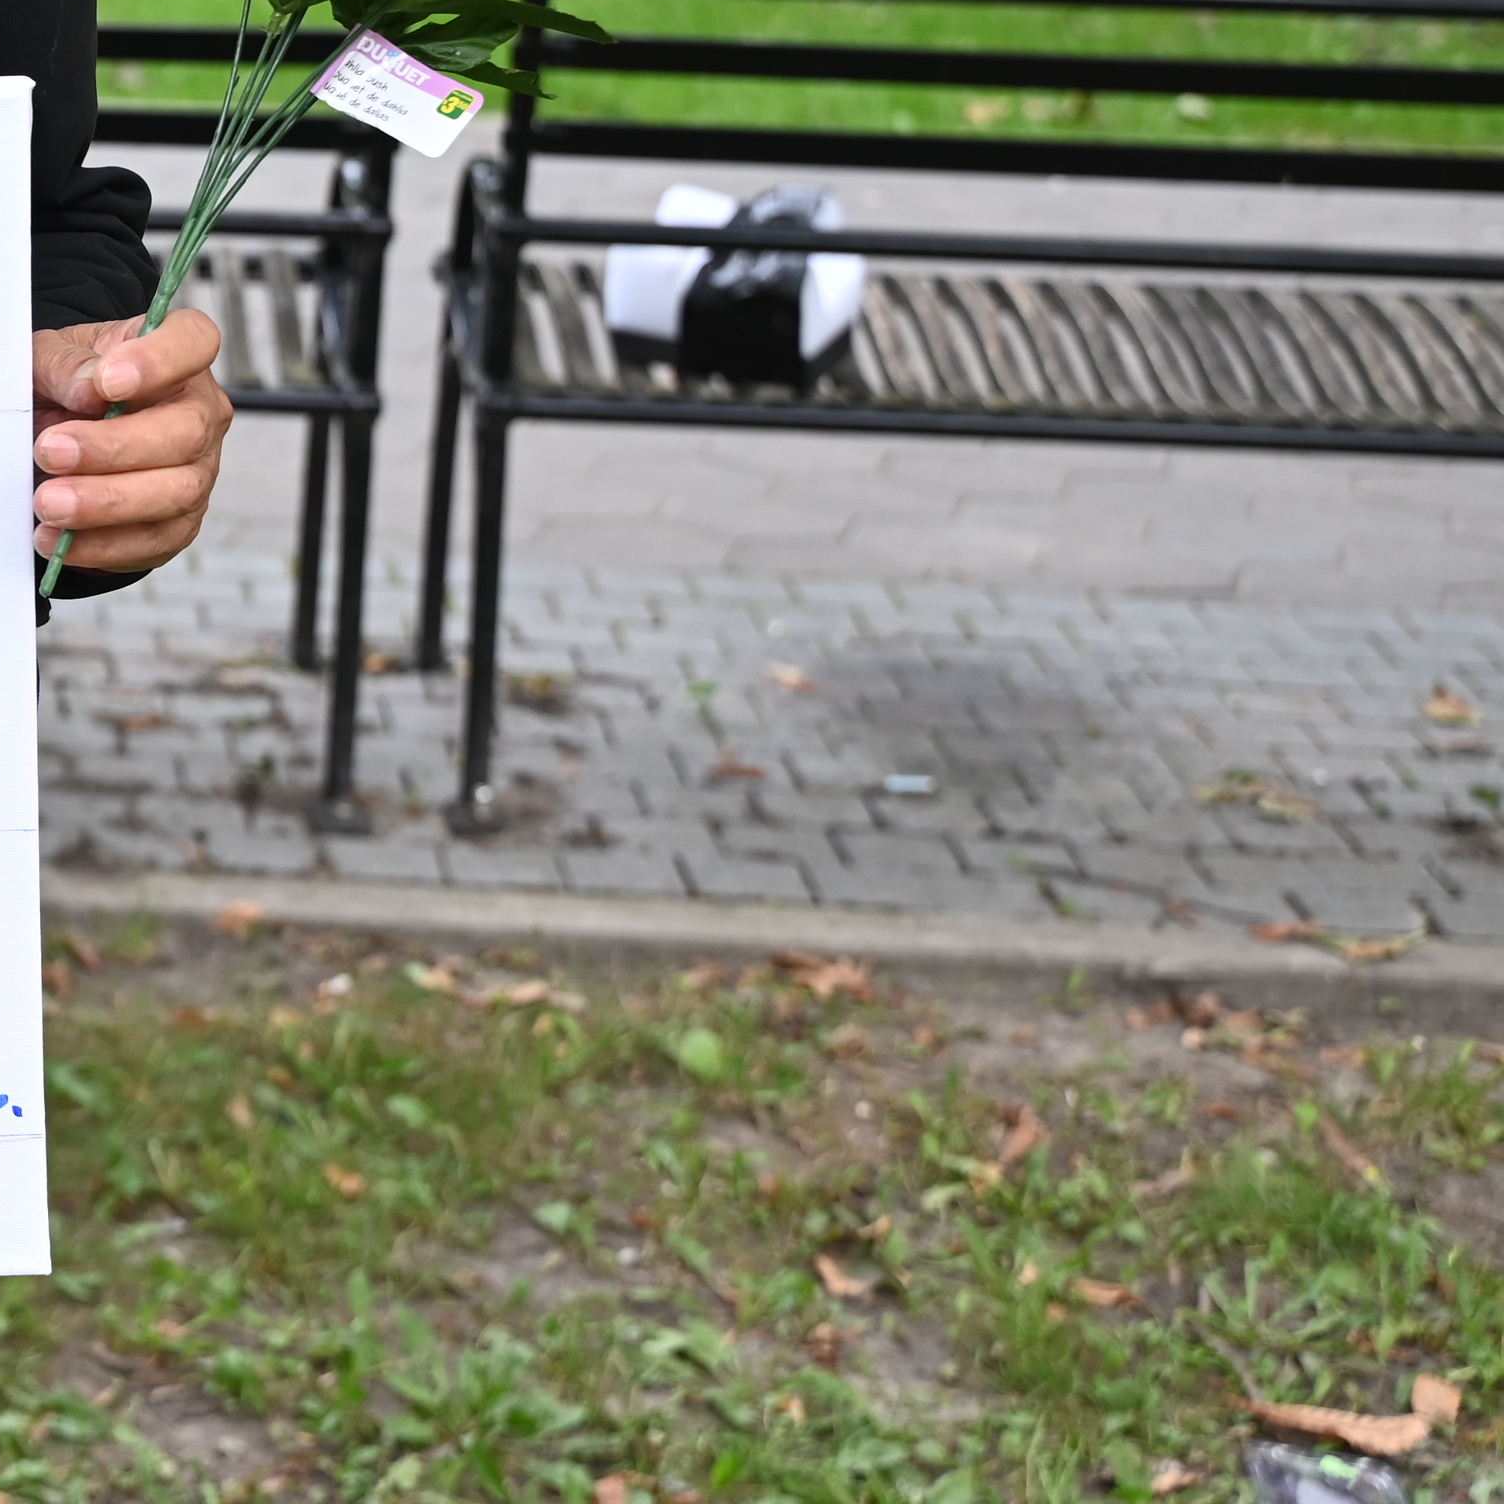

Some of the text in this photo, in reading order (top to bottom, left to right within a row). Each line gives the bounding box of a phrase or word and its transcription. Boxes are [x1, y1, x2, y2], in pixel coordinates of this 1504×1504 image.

[348, 98, 361, 109] de
[366, 92, 379, 102] de
[380, 98, 408, 116] dahlia
